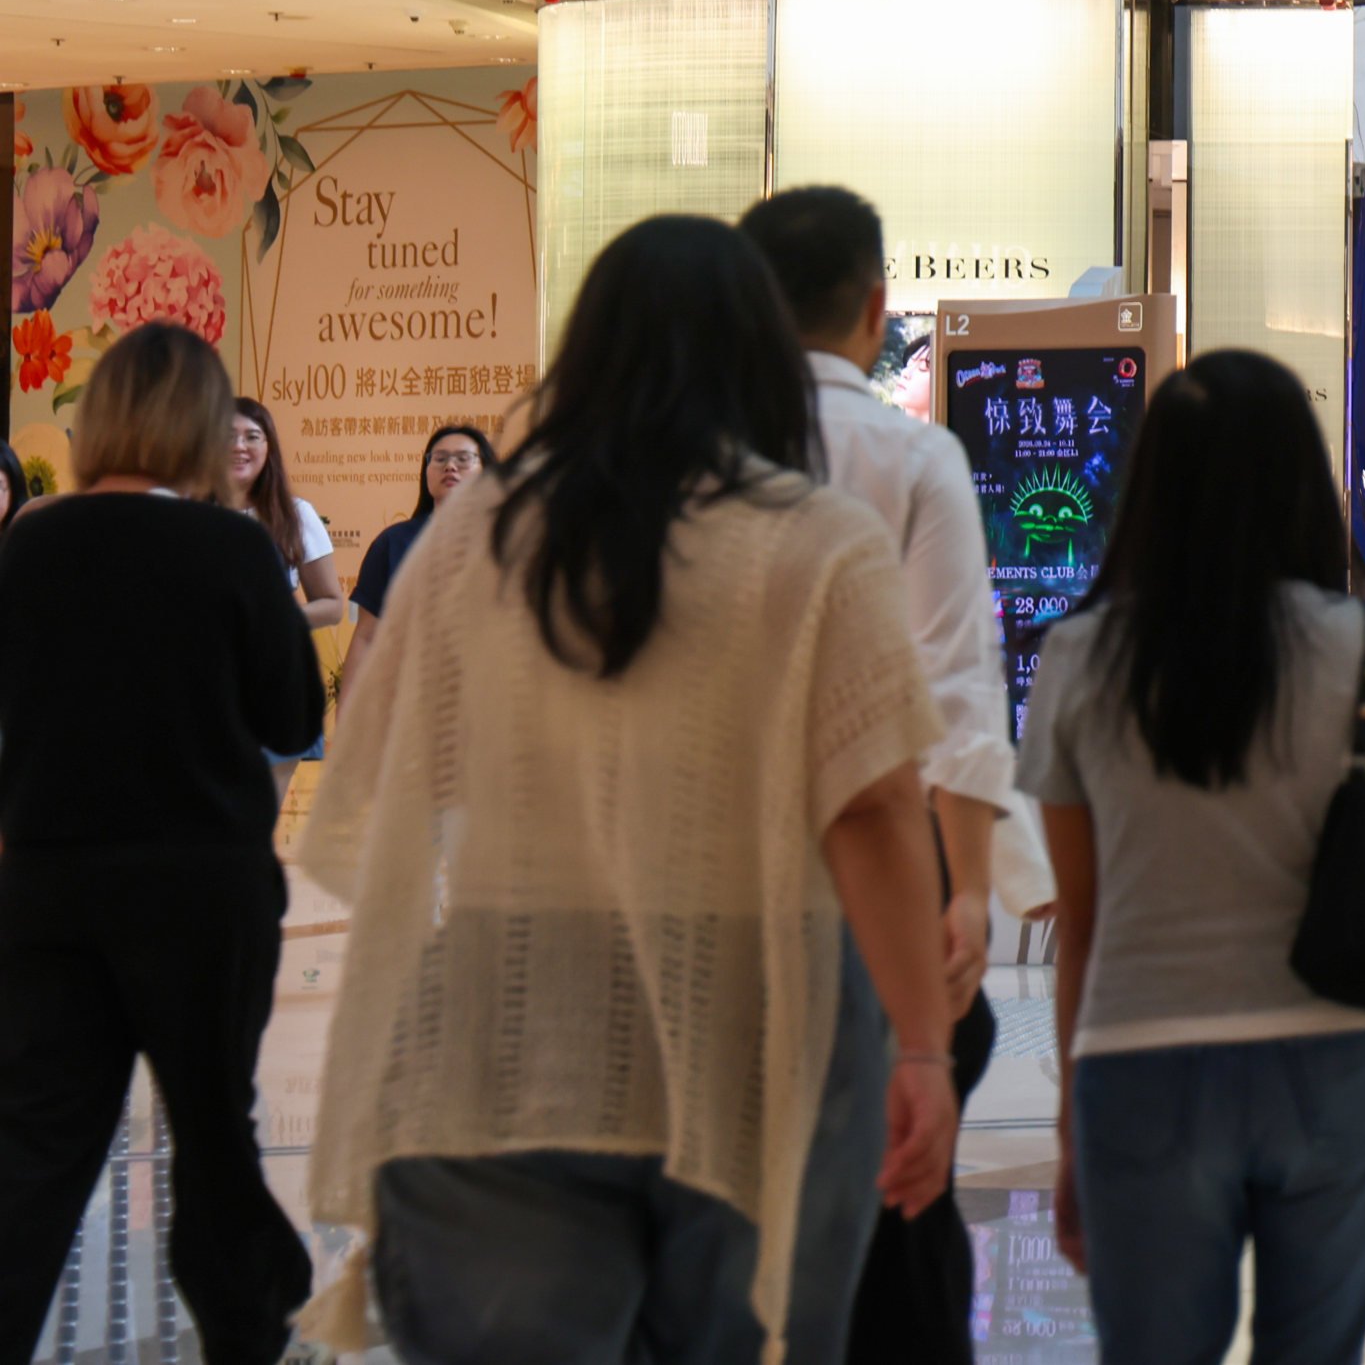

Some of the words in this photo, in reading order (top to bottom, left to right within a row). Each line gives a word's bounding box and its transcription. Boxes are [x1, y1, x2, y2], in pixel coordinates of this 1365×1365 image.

[314, 175, 396, 239] Stay
[367, 228, 459, 270] tuned
[913, 255, 1050, 280] BEERS
[344, 277, 372, 307] for
[376, 275, 460, 303] something
[318, 292, 498, 343] awesome!
[945, 314, 970, 336] L2
[272, 363, 346, 406] sky100
[354, 364, 536, 398] 將以全新面貌登場
[985, 395, 1112, 436] 惊致舞会
[293, 451, 301, 464] A
[304, 450, 344, 467] dazzling
[347, 453, 367, 464] new
[370, 450, 391, 464] look
[394, 452, 407, 463] to
[327, 470, 363, 485] viewing
[988, 566, 1037, 579] EMENTS
[1040, 566, 1075, 579] CLUB
[1015, 596, 1068, 617] 28,000
[1017, 654, 1041, 674] 1,0
